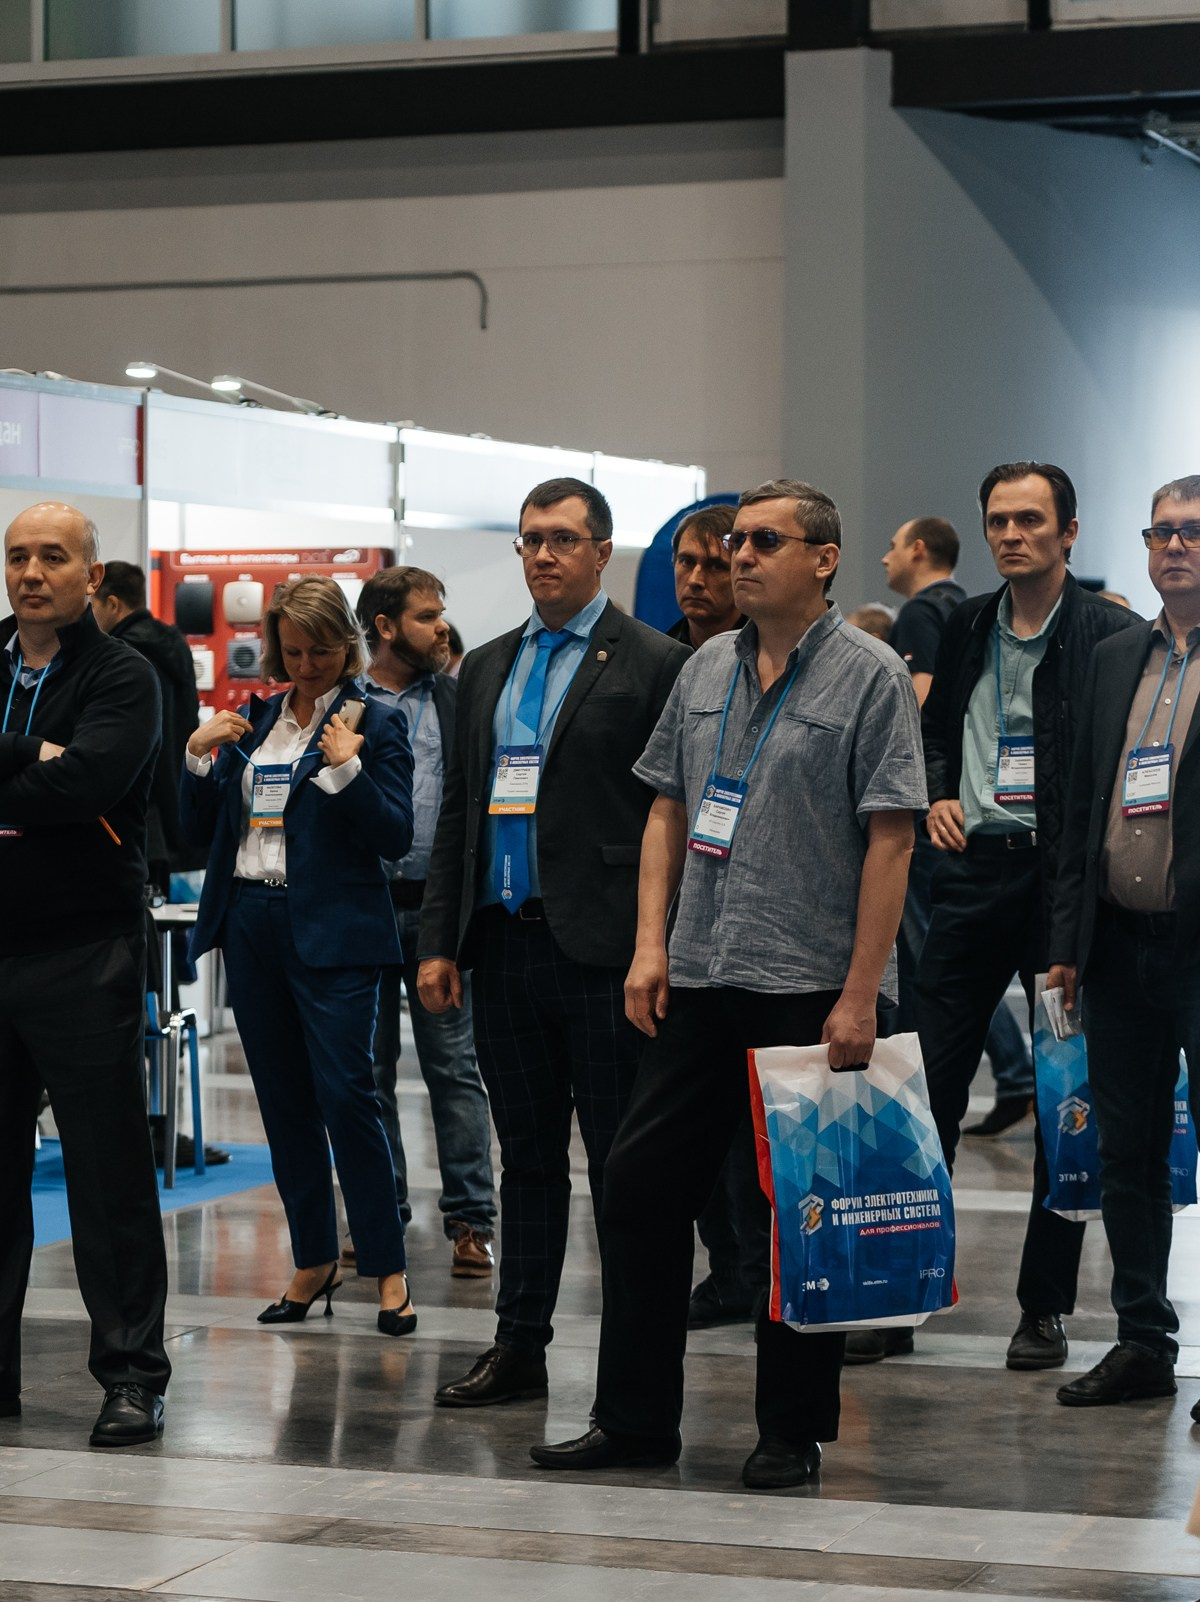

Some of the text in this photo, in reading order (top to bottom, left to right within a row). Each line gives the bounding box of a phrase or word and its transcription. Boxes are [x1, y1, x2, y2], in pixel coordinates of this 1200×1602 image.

[1127, 804, 1163, 814] ПОСЕТИТЕЛЬ
[692, 842, 722, 856] ПОСЕТИТЕЛЬ
[1058, 1173, 1077, 1182] ЭТМ
[831, 1188, 939, 1211] ФОРУМ ЭЛЕКТРОТЕХНИКИ
[832, 1203, 941, 1226] И ИНЖЕНЕРНЫХ СИСТЕМ
[859, 1221, 940, 1237] для профессионалов
